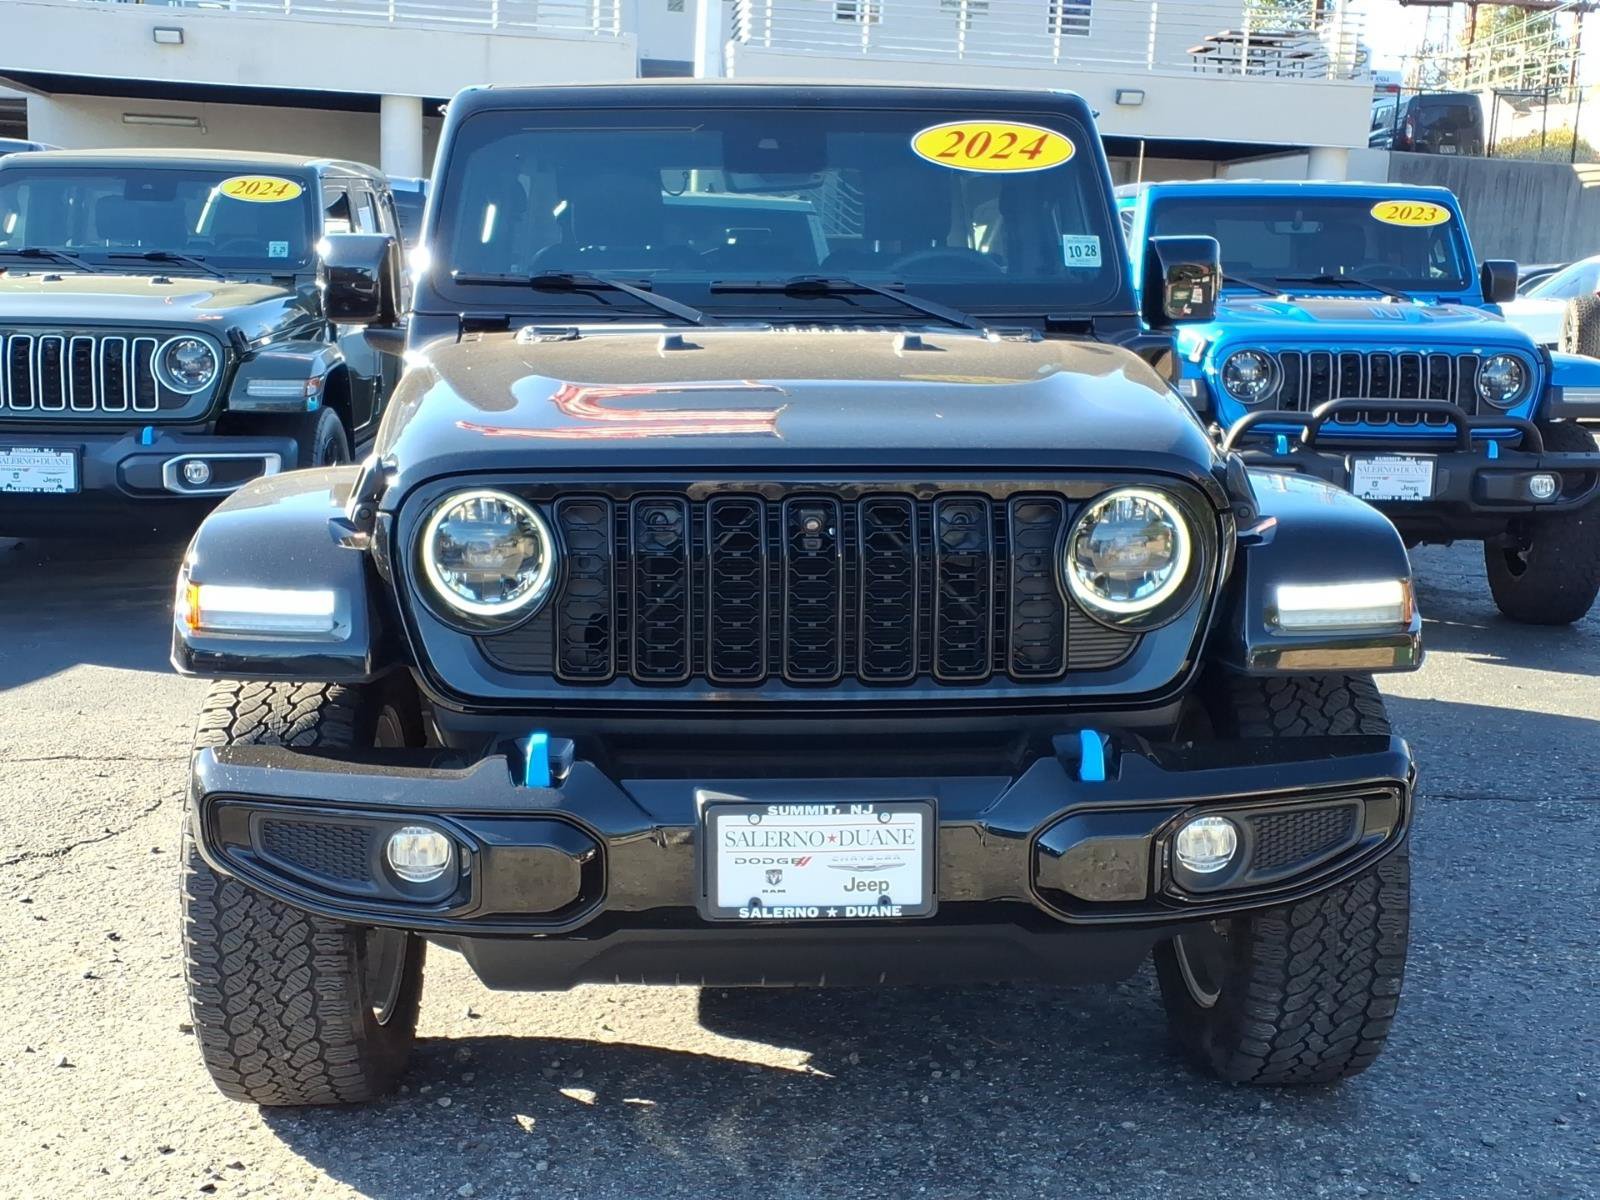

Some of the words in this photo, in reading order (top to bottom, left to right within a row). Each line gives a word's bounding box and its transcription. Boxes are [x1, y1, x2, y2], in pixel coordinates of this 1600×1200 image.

[936, 131, 1050, 160] 2024
[231, 181, 289, 196] 2024
[1386, 206, 1437, 221] 2023
[1069, 245, 1082, 258] 10
[1084, 244, 1097, 257] 28
[1400, 484, 1419, 492] Jeep
[767, 805, 840, 817] SUMMIT,
[850, 804, 874, 815] NJ
[725, 830, 825, 848] SALERNO
[839, 828, 915, 846] DUANE
[734, 857, 803, 865] DODGE
[843, 876, 890, 895] Jeep
[739, 906, 820, 919] SALERNO
[845, 905, 903, 918] DUANE
